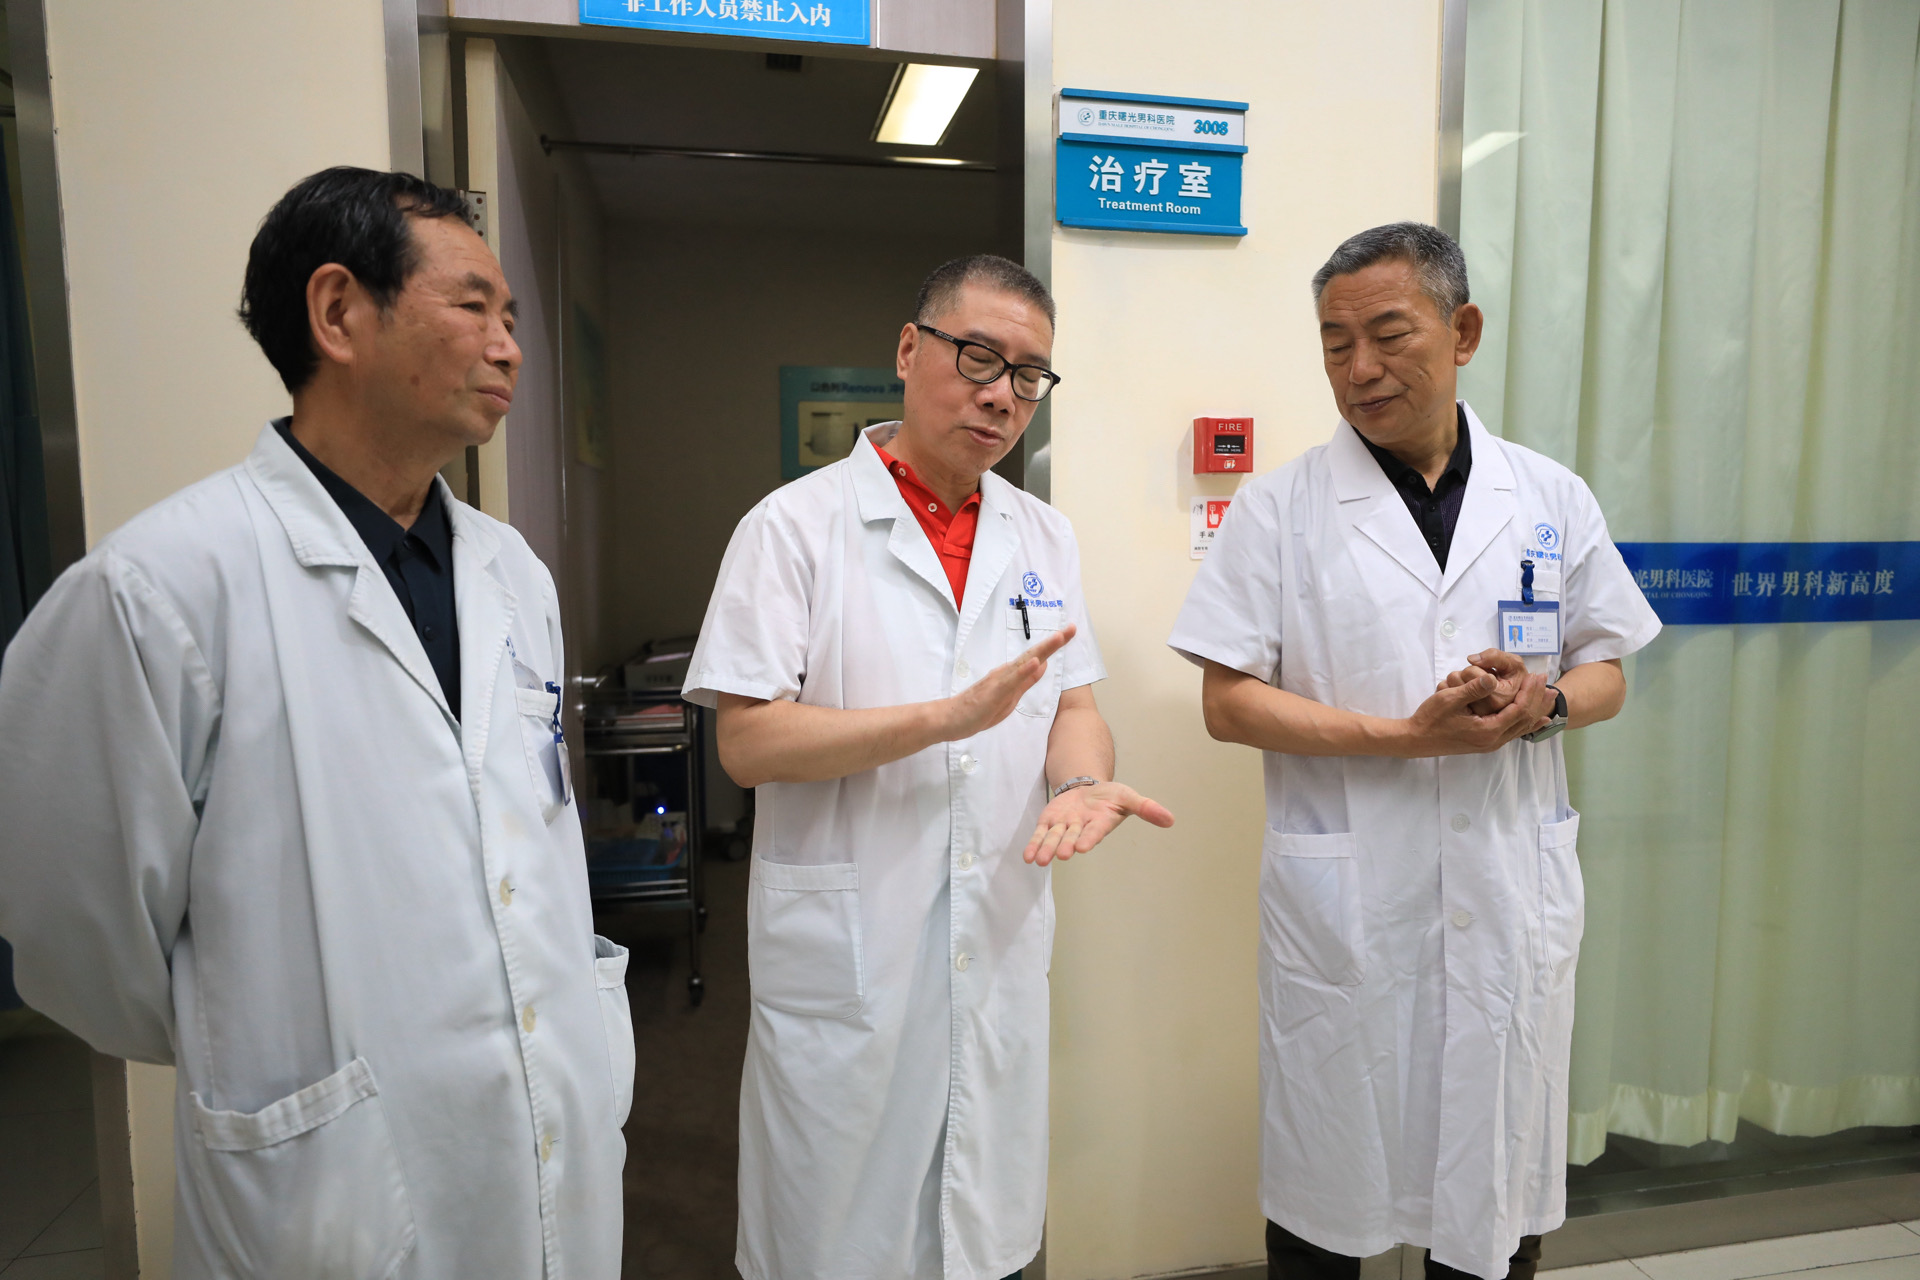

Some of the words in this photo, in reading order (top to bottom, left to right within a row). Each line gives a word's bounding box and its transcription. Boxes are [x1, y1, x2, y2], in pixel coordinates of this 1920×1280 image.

[621, 0, 831, 28] 非工作人员禁止入内
[1098, 109, 1176, 126] 重庆曙光男科医院
[1193, 119, 1229, 136] 3008
[1088, 155, 1212, 199] 治疗室
[1098, 197, 1164, 213] Treatment
[1165, 201, 1201, 215] Room
[1218, 423, 1243, 431] FIRE
[1731, 569, 1895, 597] 世界男科新高度
[1009, 597, 1063, 607] 重曙光男科医院
